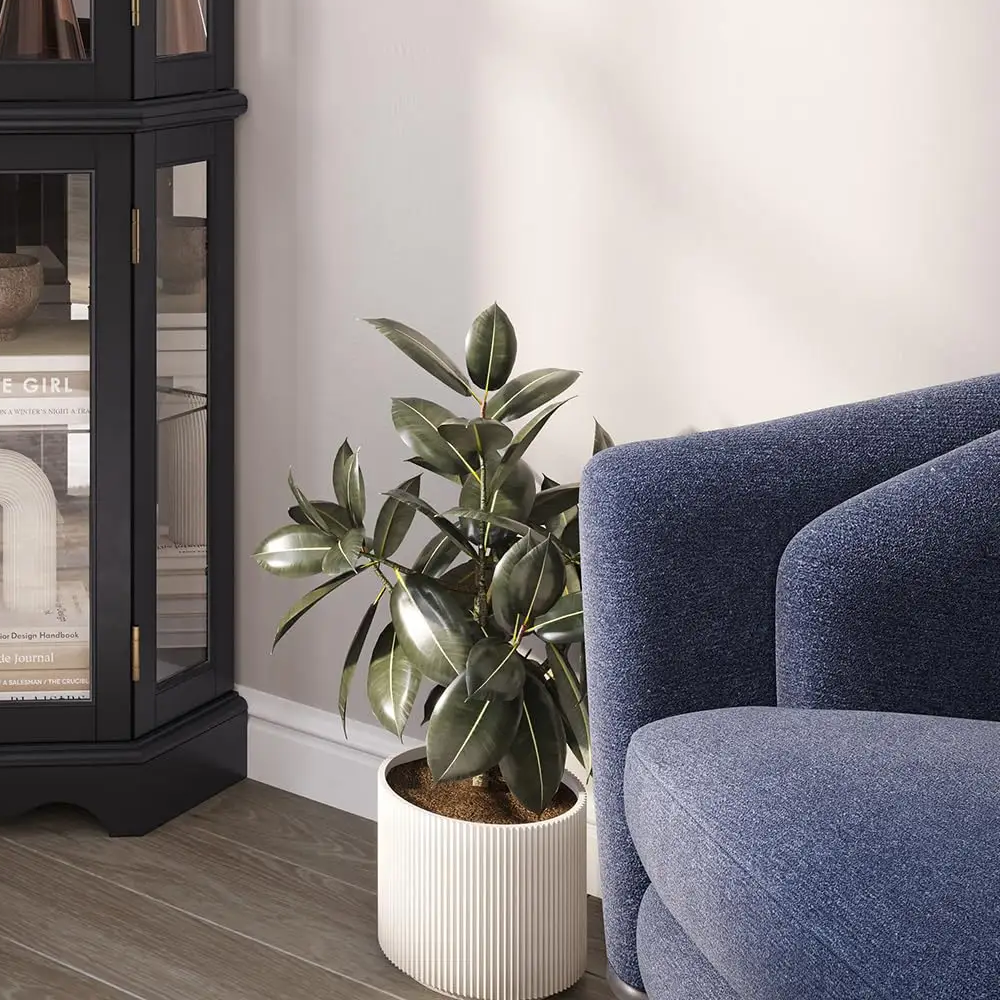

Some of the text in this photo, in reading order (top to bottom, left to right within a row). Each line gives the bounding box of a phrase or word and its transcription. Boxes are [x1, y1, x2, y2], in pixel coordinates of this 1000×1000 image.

[23, 377, 73, 394] GIRL
[7, 408, 13, 416] A
[13, 408, 47, 416] WINTER'S
[11, 631, 38, 640] Design
[39, 631, 79, 639] Handbook
[14, 652, 55, 665] Journal
